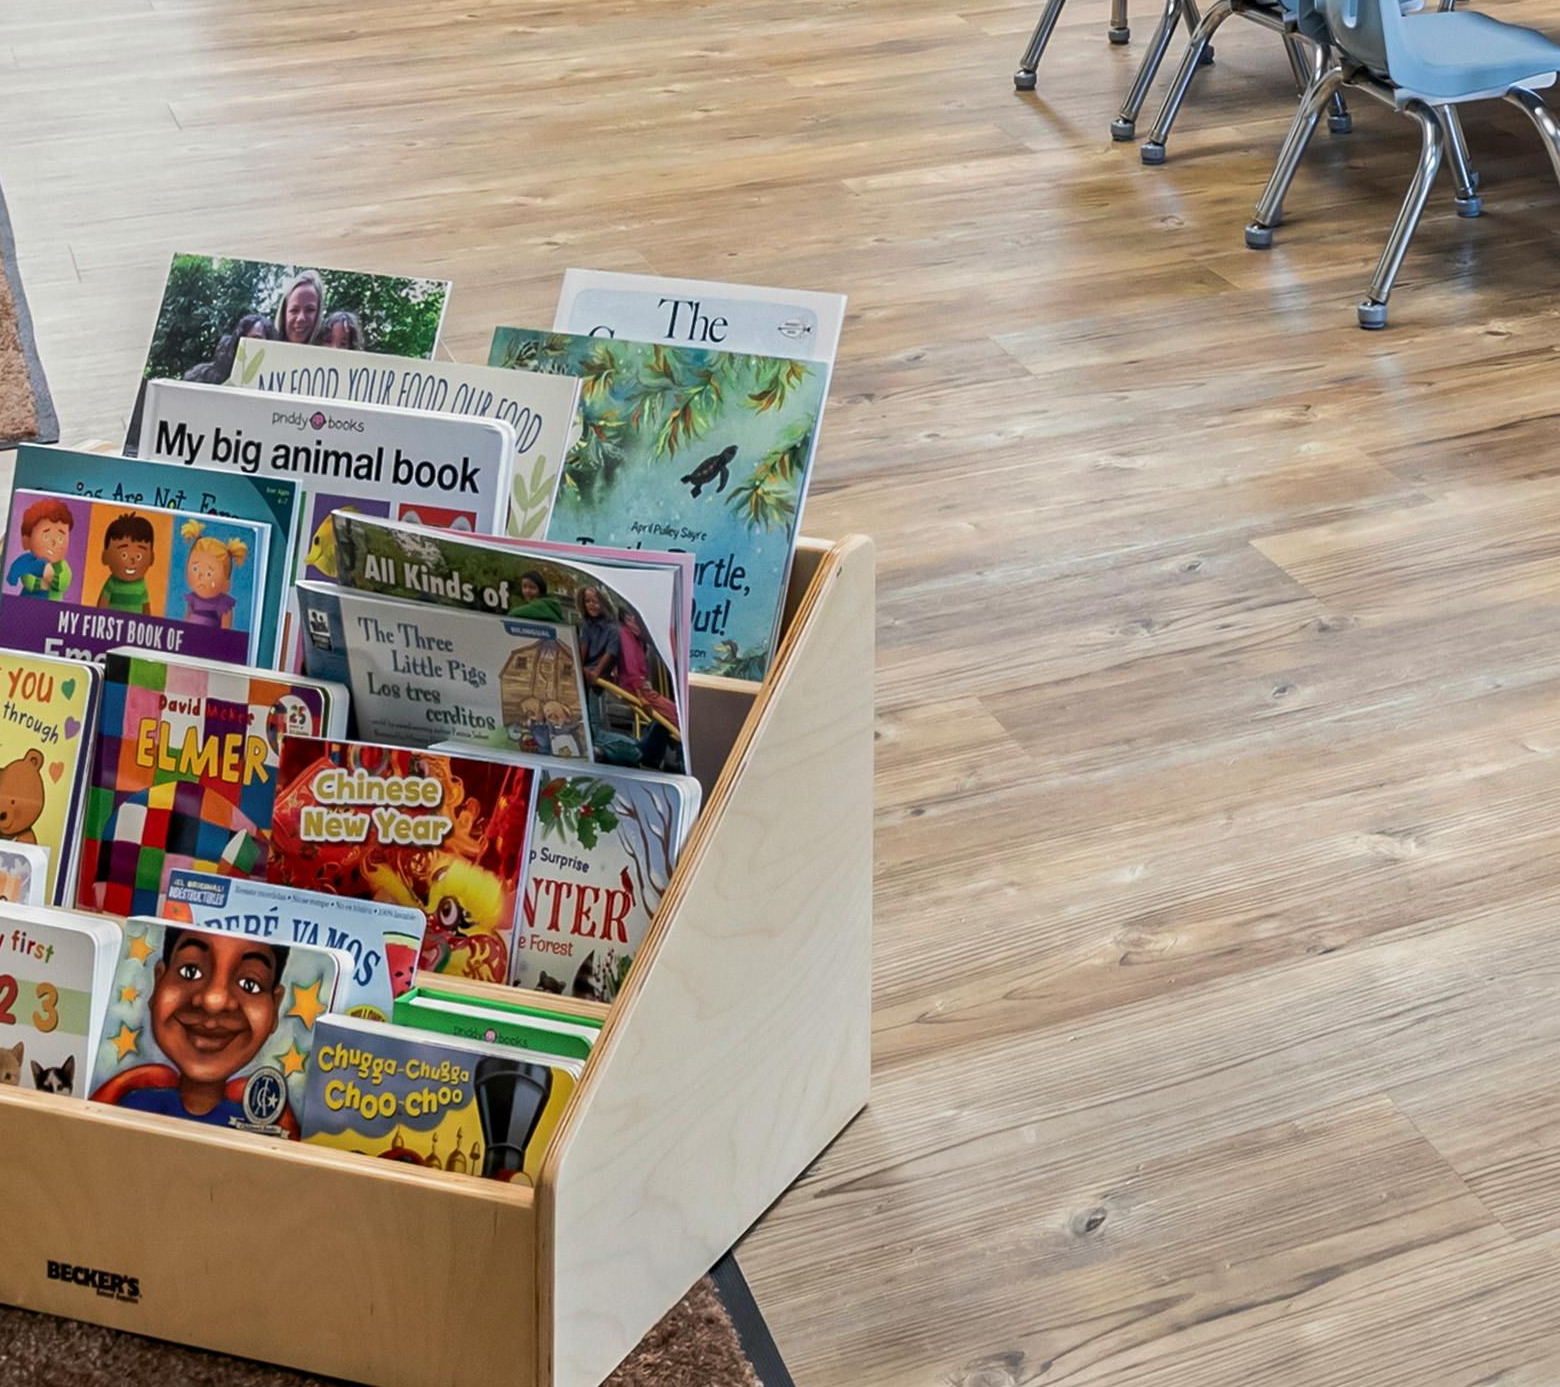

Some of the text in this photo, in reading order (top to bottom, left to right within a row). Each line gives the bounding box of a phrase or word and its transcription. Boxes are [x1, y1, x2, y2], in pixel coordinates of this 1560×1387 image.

[657, 298, 729, 343] The
[291, 367, 340, 400] FOOD
[348, 367, 396, 406] YOUR
[398, 372, 449, 413] FOOD
[272, 411, 365, 433] priddy books
[156, 420, 481, 494] My big animal book
[364, 554, 509, 609] All Kinds of
[58, 611, 184, 651] MY FIRST BOOK OF
[358, 617, 454, 652] The Three
[8, 667, 54, 704] YOU
[367, 672, 441, 703] Los tres
[391, 650, 487, 688] Little Pigs
[3, 701, 60, 745] through
[159, 694, 255, 726] David McKee
[290, 705, 307, 725] 25
[426, 706, 496, 731] cerditos
[137, 717, 269, 787] ELMER
[314, 771, 441, 805] Chinese
[301, 808, 452, 846] New Year
[540, 847, 590, 873] Surprise
[11, 929, 55, 964] first
[530, 934, 573, 956] Forest
[32, 982, 59, 1033] 3
[317, 1042, 470, 1086] Chugga-Chugga
[47, 1258, 140, 1298] BECKER'S
